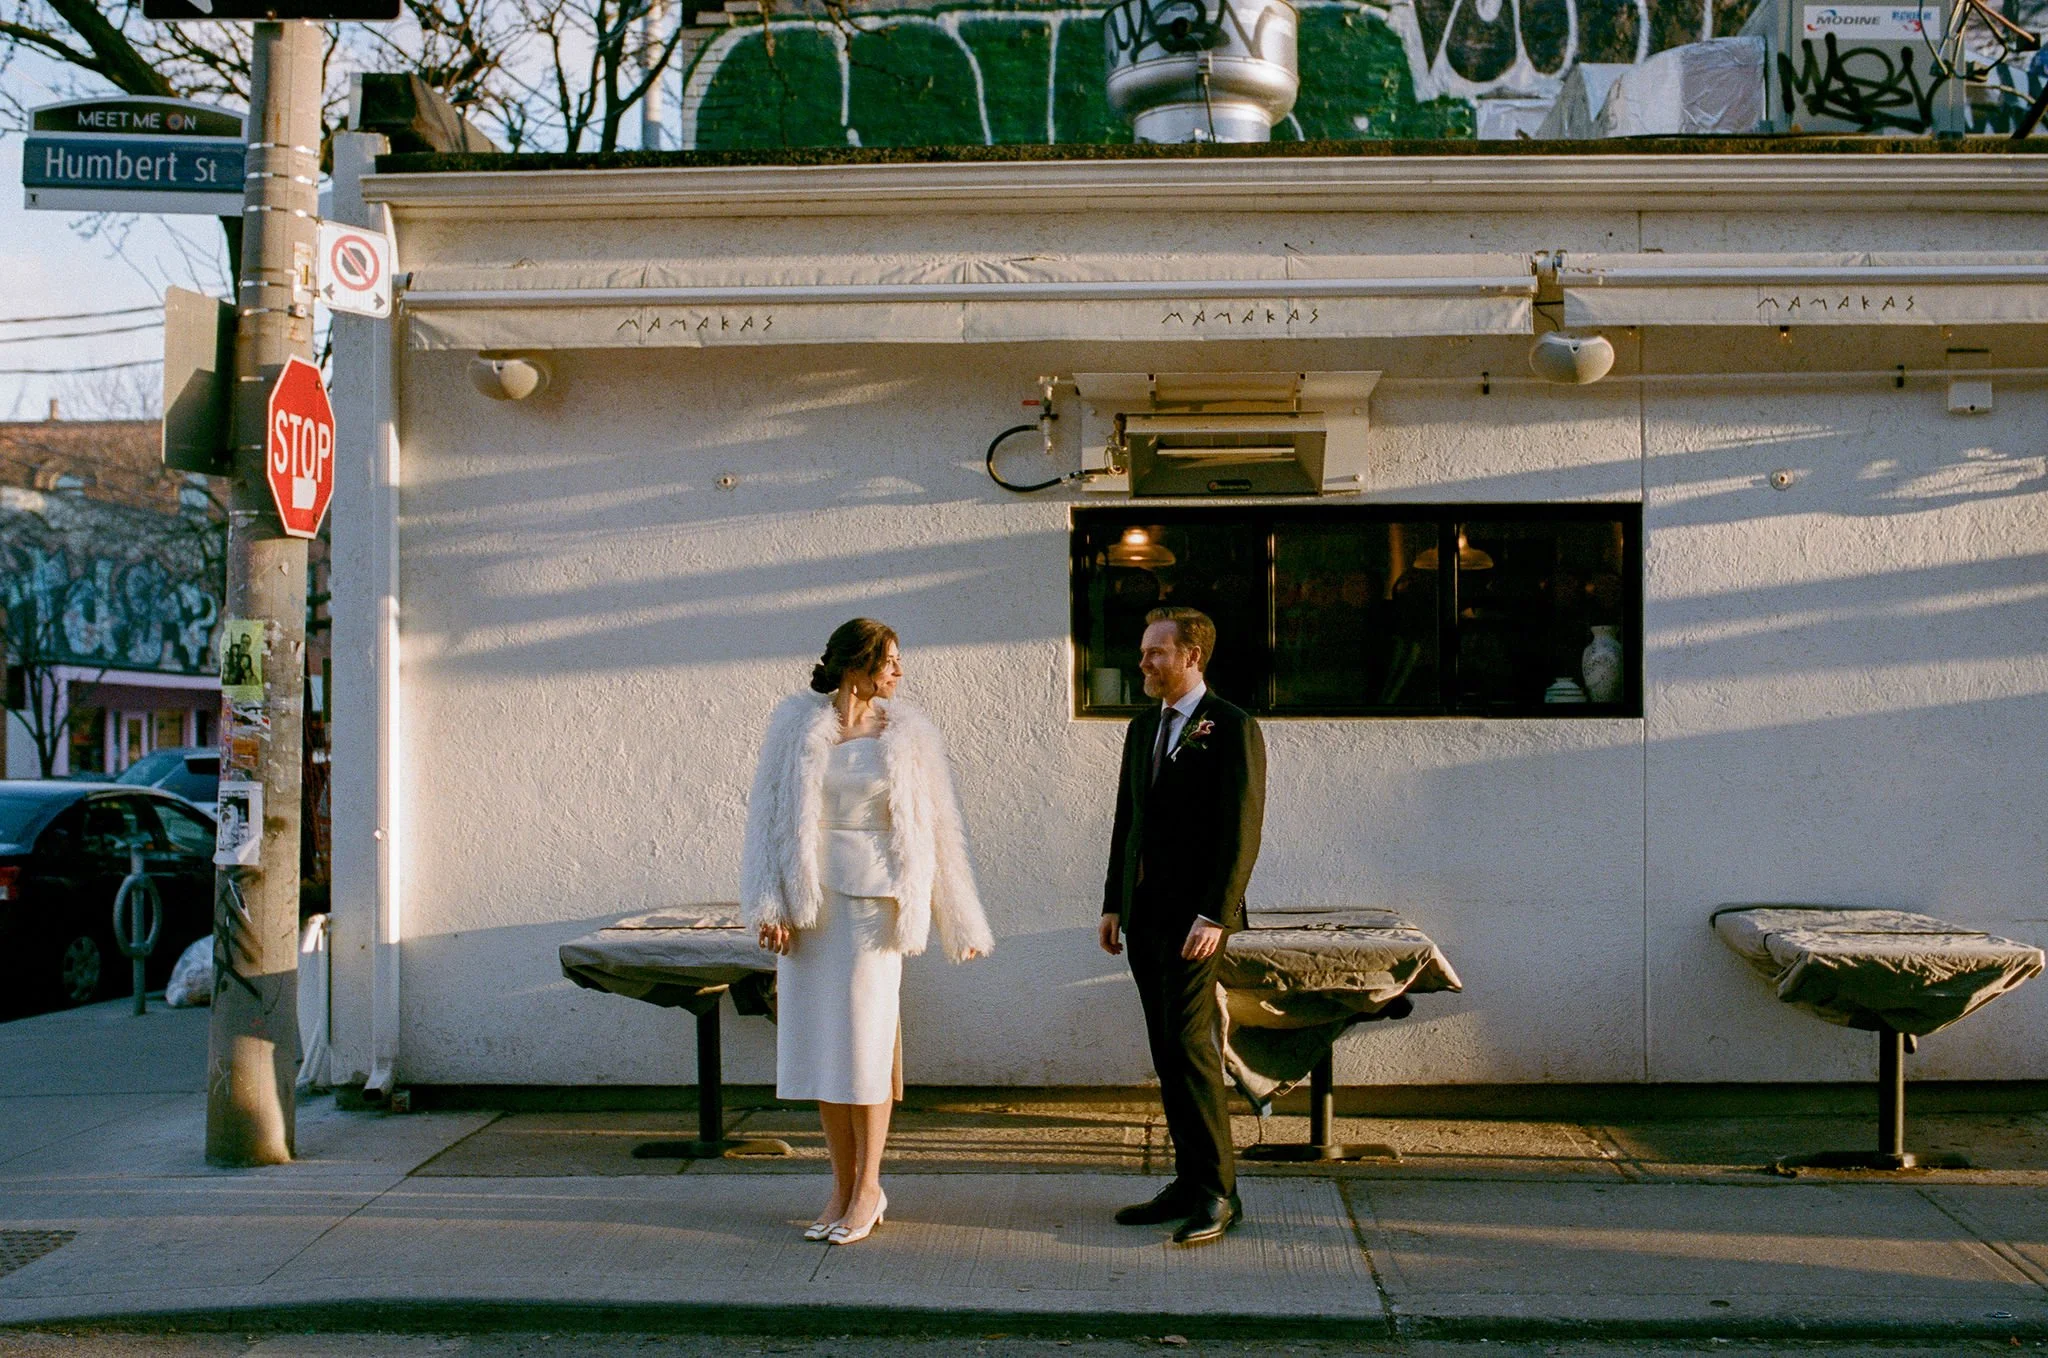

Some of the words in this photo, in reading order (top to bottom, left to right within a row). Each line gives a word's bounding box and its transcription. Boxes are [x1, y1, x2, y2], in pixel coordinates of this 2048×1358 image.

[1816, 15, 1881, 25] MODINE
[77, 110, 129, 128] MEET
[132, 112, 161, 129] ME
[166, 111, 197, 131] ON
[45, 146, 178, 182] Humbert
[194, 156, 217, 183] St
[1757, 295, 1915, 312] MAMAKAS
[616, 314, 773, 333] MAMAKAS
[1162, 308, 1319, 326] MAMAKAS
[274, 409, 332, 483] STOP
